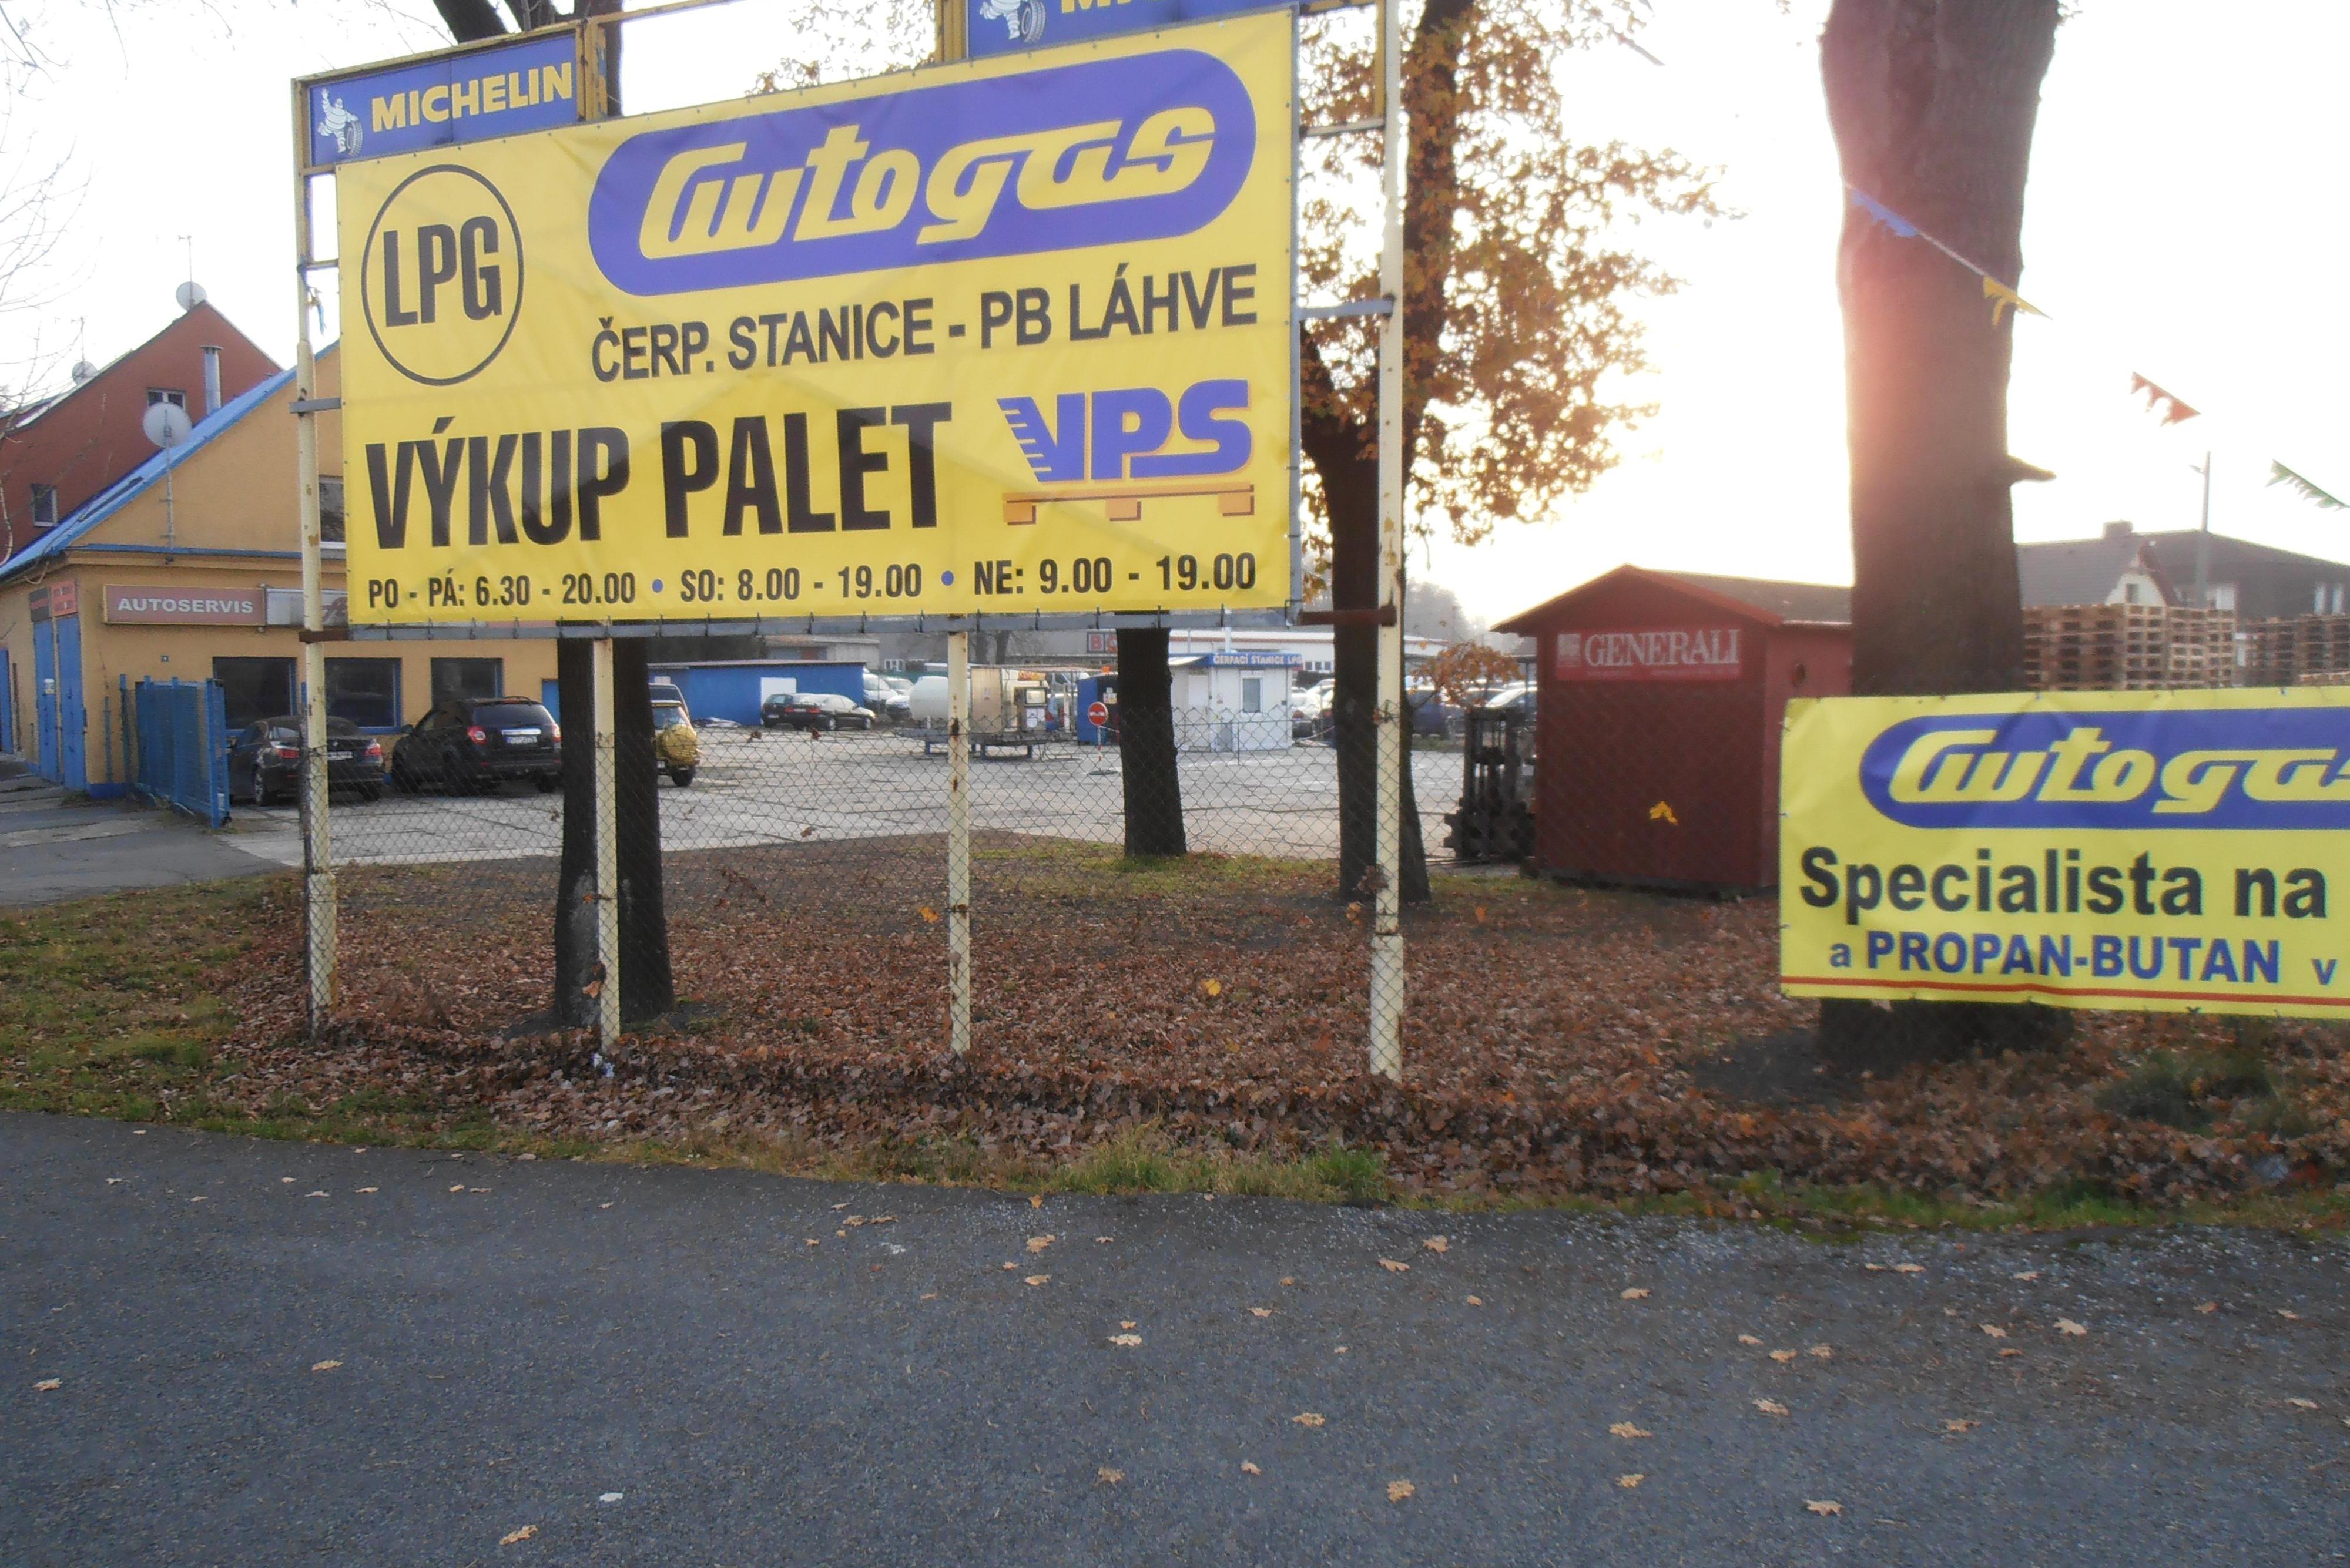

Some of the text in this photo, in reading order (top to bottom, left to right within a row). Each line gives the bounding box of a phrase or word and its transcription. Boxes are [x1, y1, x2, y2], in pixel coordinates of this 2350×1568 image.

[371, 62, 572, 133] MICHELIN
[639, 106, 1215, 259] Autogas
[383, 215, 502, 327] LPG
[592, 317, 714, 382] ČERP.
[728, 298, 934, 371] STANICE
[981, 287, 1052, 349] PB
[1070, 263, 1258, 341] LÁHVE
[996, 379, 1252, 482] VPS
[365, 401, 952, 549] VÝKUP PALET
[118, 597, 253, 613] AUTOSERVIS
[368, 578, 398, 608] PO
[428, 568, 465, 607] PÁ:
[475, 575, 531, 606] 6.30
[562, 572, 636, 604] 20.00
[680, 569, 724, 602] SO:
[737, 568, 800, 600] 8.00
[838, 563, 922, 598] 19.00
[974, 559, 1023, 595] NE:
[1039, 556, 1112, 593] 9.00
[1156, 553, 1256, 590] 19.00
[1585, 629, 1740, 666] GENERALI
[1889, 727, 2350, 813] Autoga
[1799, 847, 2326, 925] Specialista na
[1829, 931, 2338, 986] a PROPAN-BUTAN v
